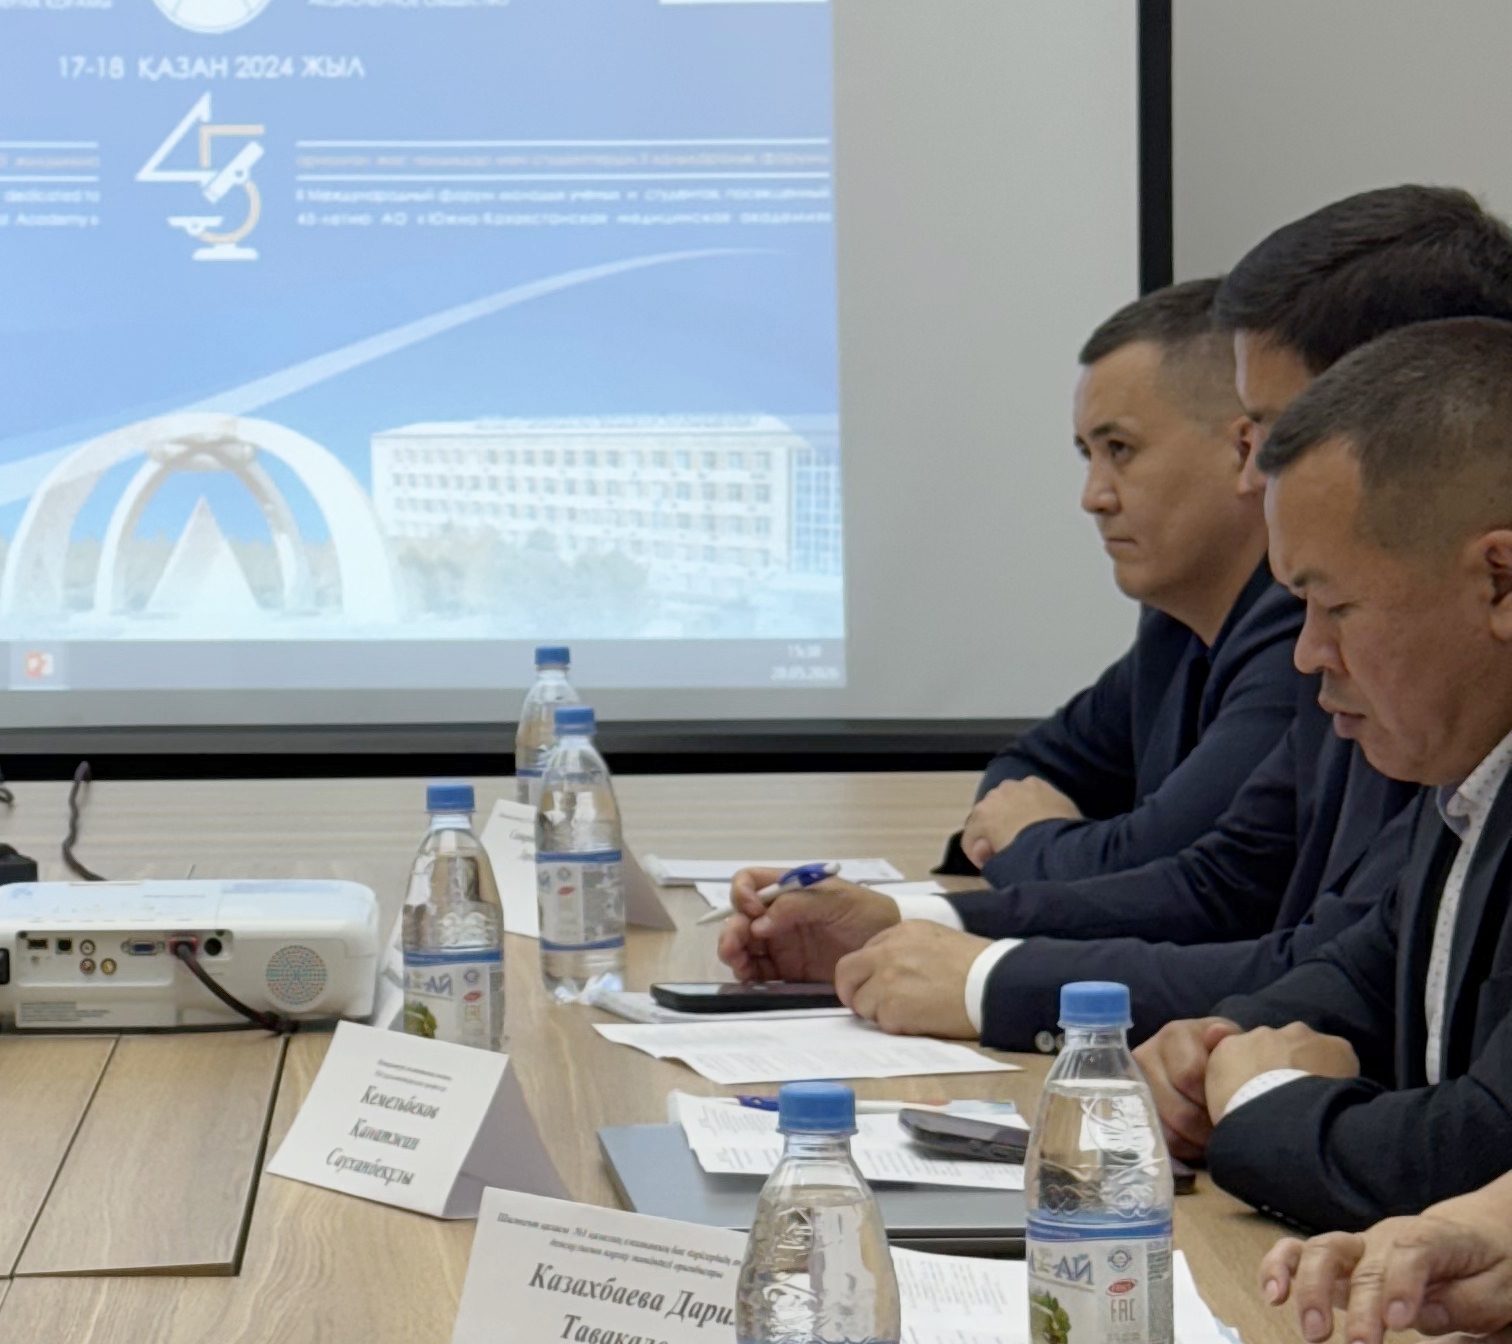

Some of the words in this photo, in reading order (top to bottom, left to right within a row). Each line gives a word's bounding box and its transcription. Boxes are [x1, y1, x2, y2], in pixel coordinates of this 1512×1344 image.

[59, 56, 125, 79] 17-18
[235, 56, 293, 79] 2024
[300, 56, 366, 79] ЖЫЛ
[528, 1262, 666, 1312] Казахбаева
[663, 1289, 737, 1329] Дари
